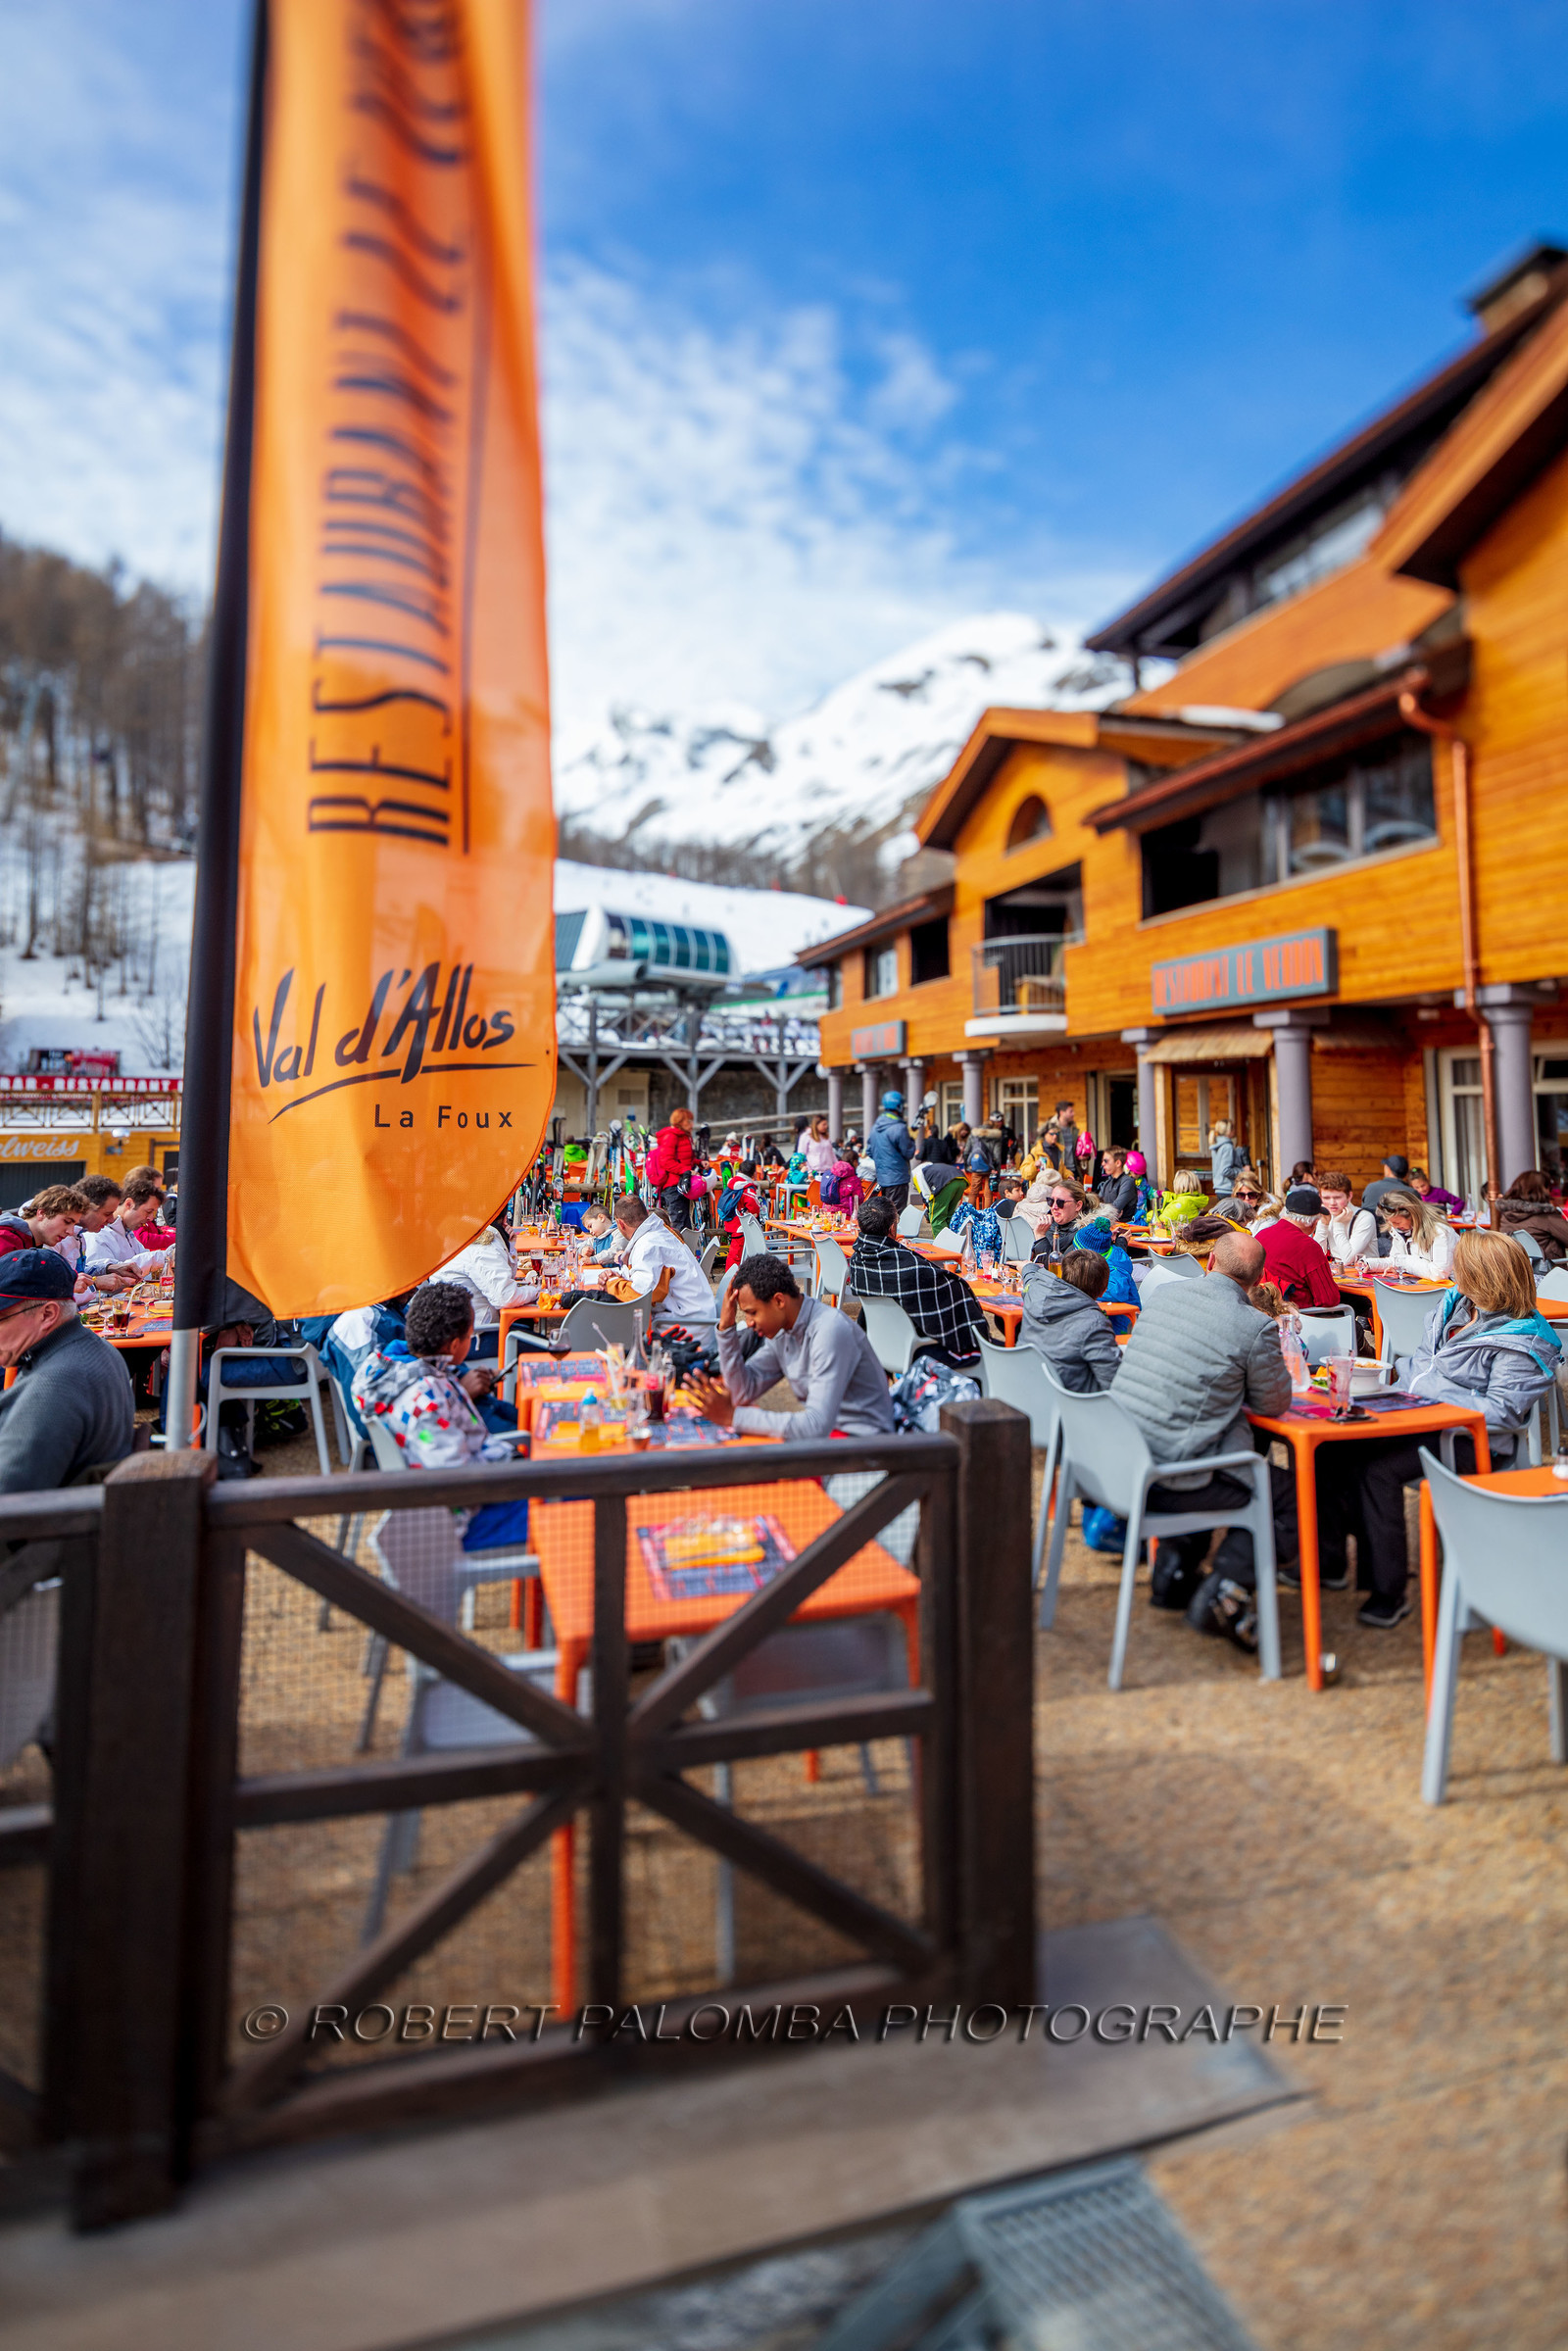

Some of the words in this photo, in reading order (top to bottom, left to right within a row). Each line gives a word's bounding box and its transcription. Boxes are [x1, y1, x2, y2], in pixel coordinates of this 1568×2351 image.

[308, 306, 453, 849] RESTAURANT
[253, 966, 326, 1089] Val
[334, 961, 515, 1084] d'Allos
[0, 1076, 37, 1091] BAR
[54, 1077, 171, 1093] RESTAURANT
[374, 1103, 414, 1128] La
[437, 1104, 513, 1128] Foux
[0, 1137, 79, 1157] lweiss
